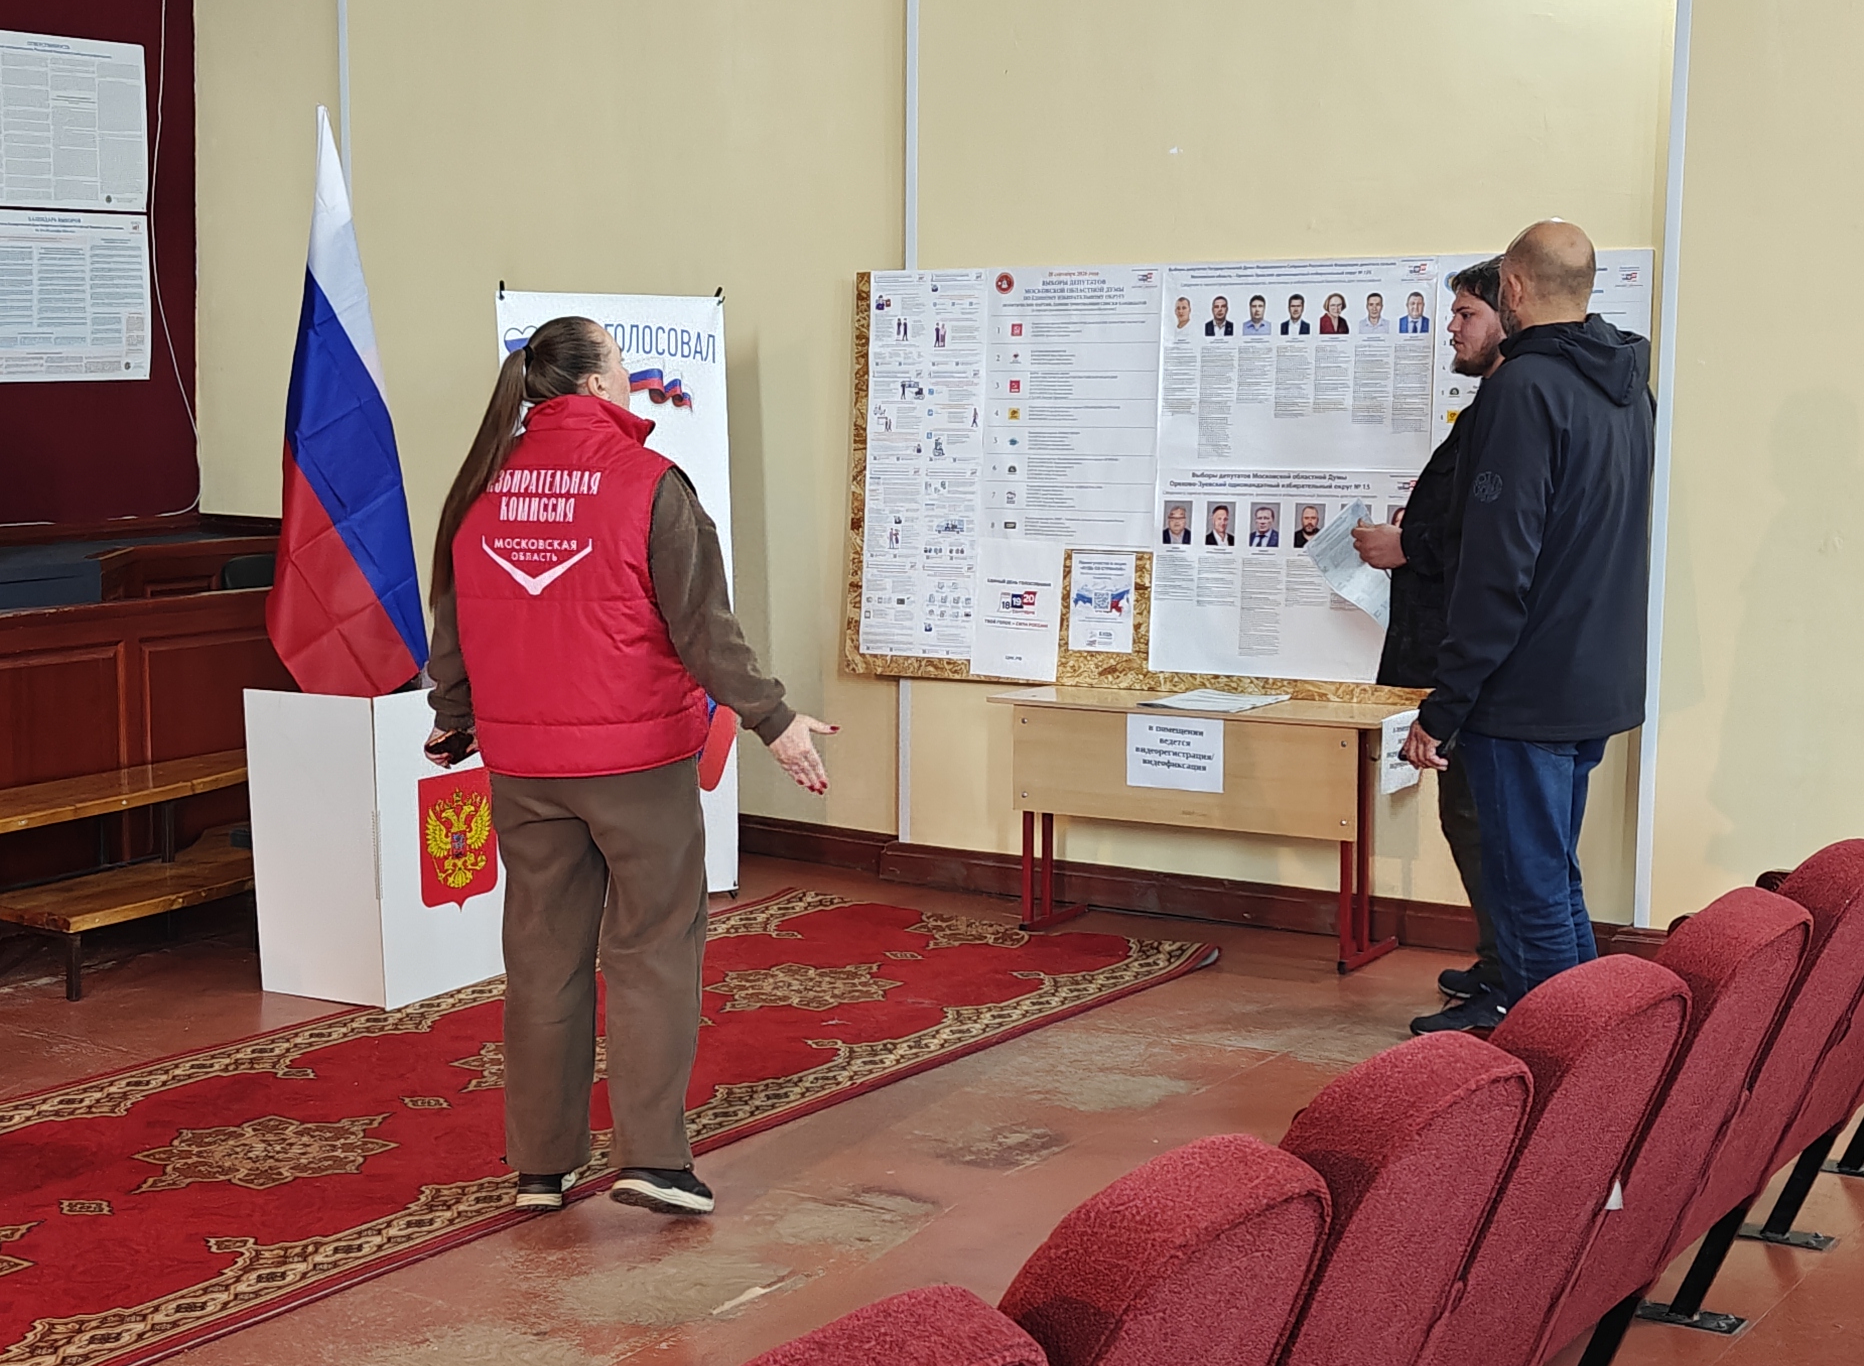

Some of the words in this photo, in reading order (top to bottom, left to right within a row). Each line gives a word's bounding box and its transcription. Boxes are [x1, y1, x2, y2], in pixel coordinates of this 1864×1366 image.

[499, 495, 575, 523] КОМИССИЯ
[493, 538, 578, 551] МОСКОВСКАЯ
[510, 551, 558, 562] ОБЛАСТЬ
[1001, 601, 1010, 610] 18
[1012, 597, 1022, 606] 19
[1023, 594, 1035, 603] 20
